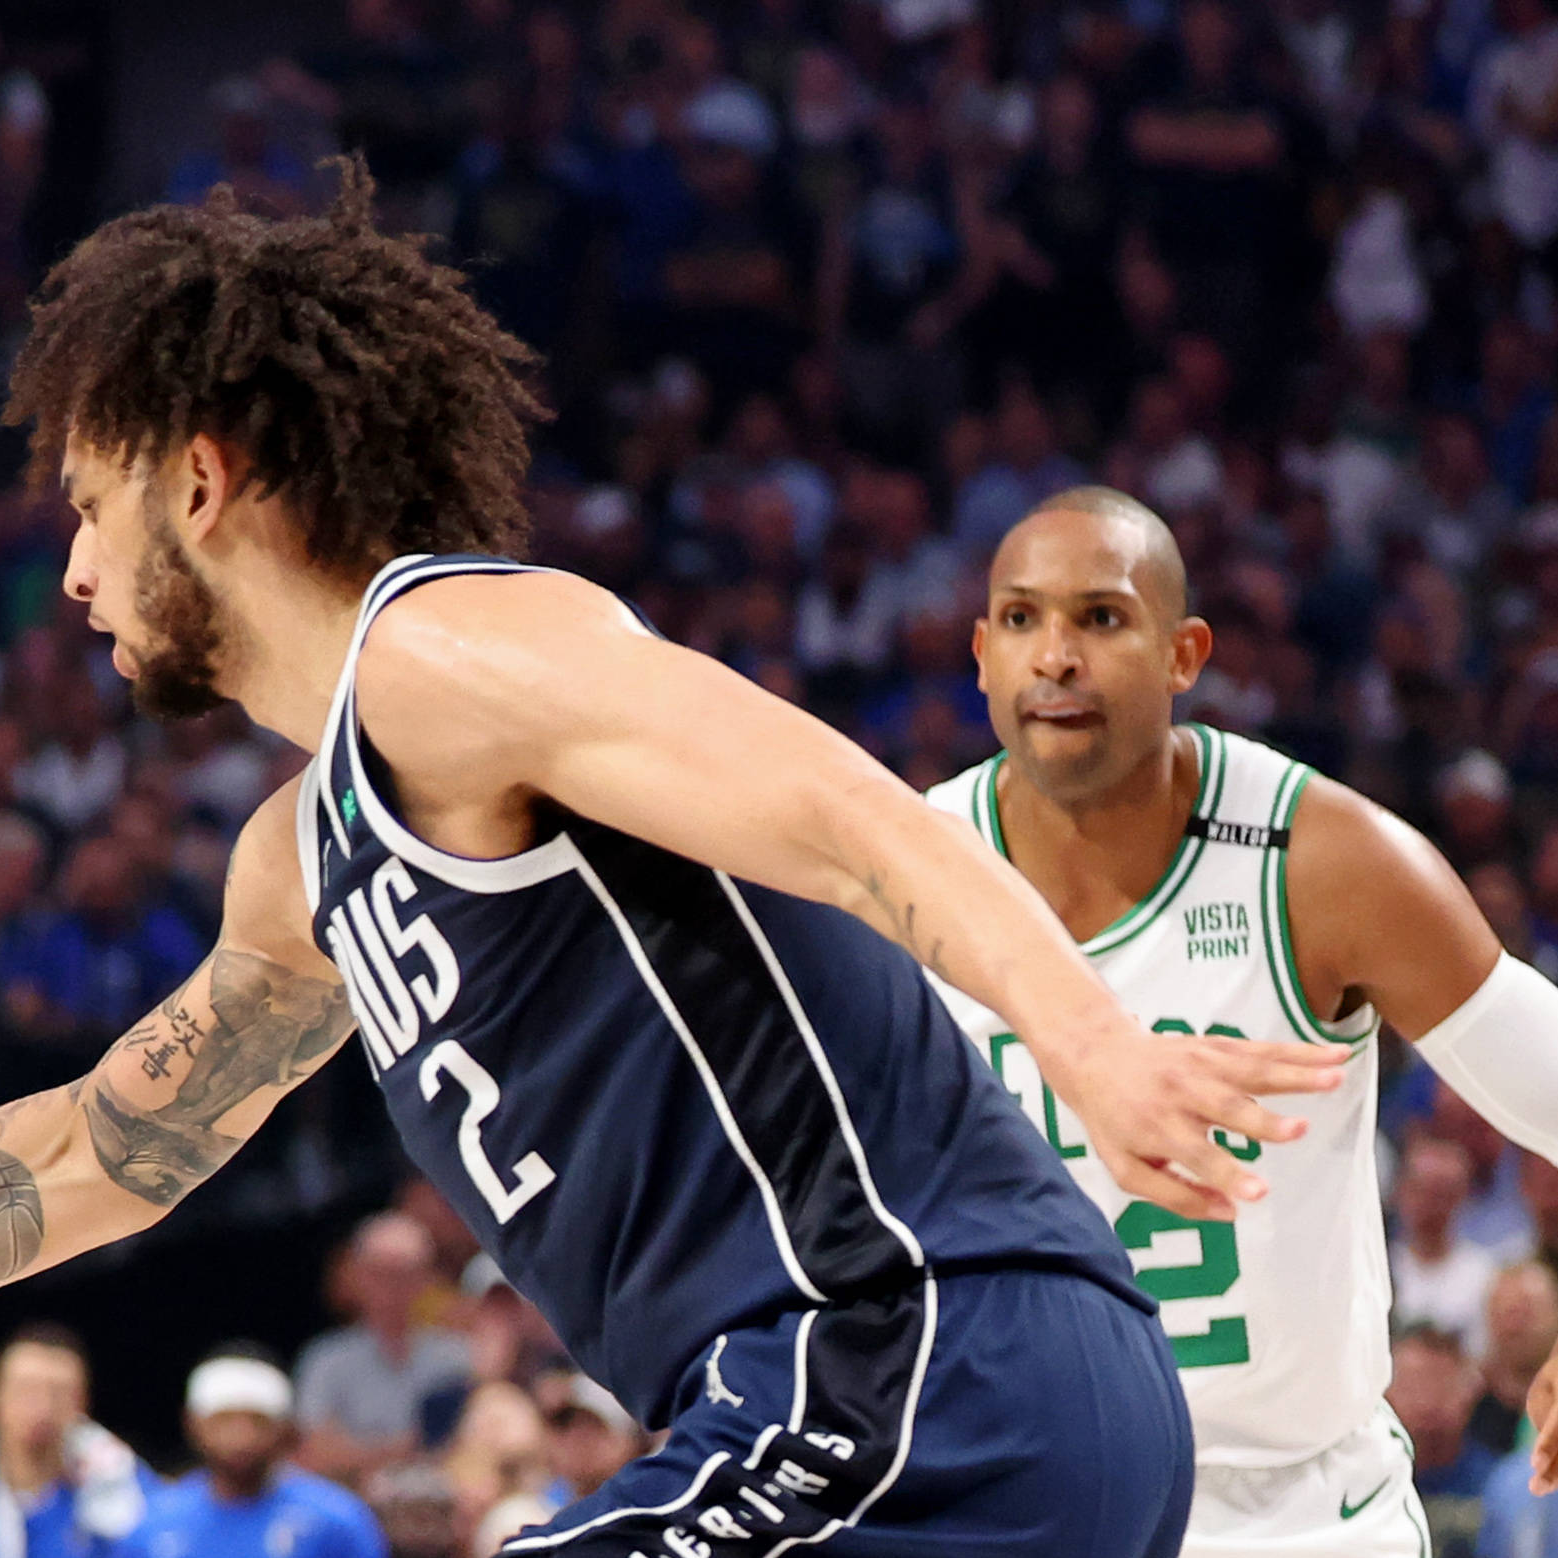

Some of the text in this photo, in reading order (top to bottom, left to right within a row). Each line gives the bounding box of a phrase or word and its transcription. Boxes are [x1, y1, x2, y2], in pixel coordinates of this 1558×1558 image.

[1183, 901, 1250, 936] VISTA
[1187, 935, 1250, 961] PRINT
[418, 1038, 557, 1226] 2
